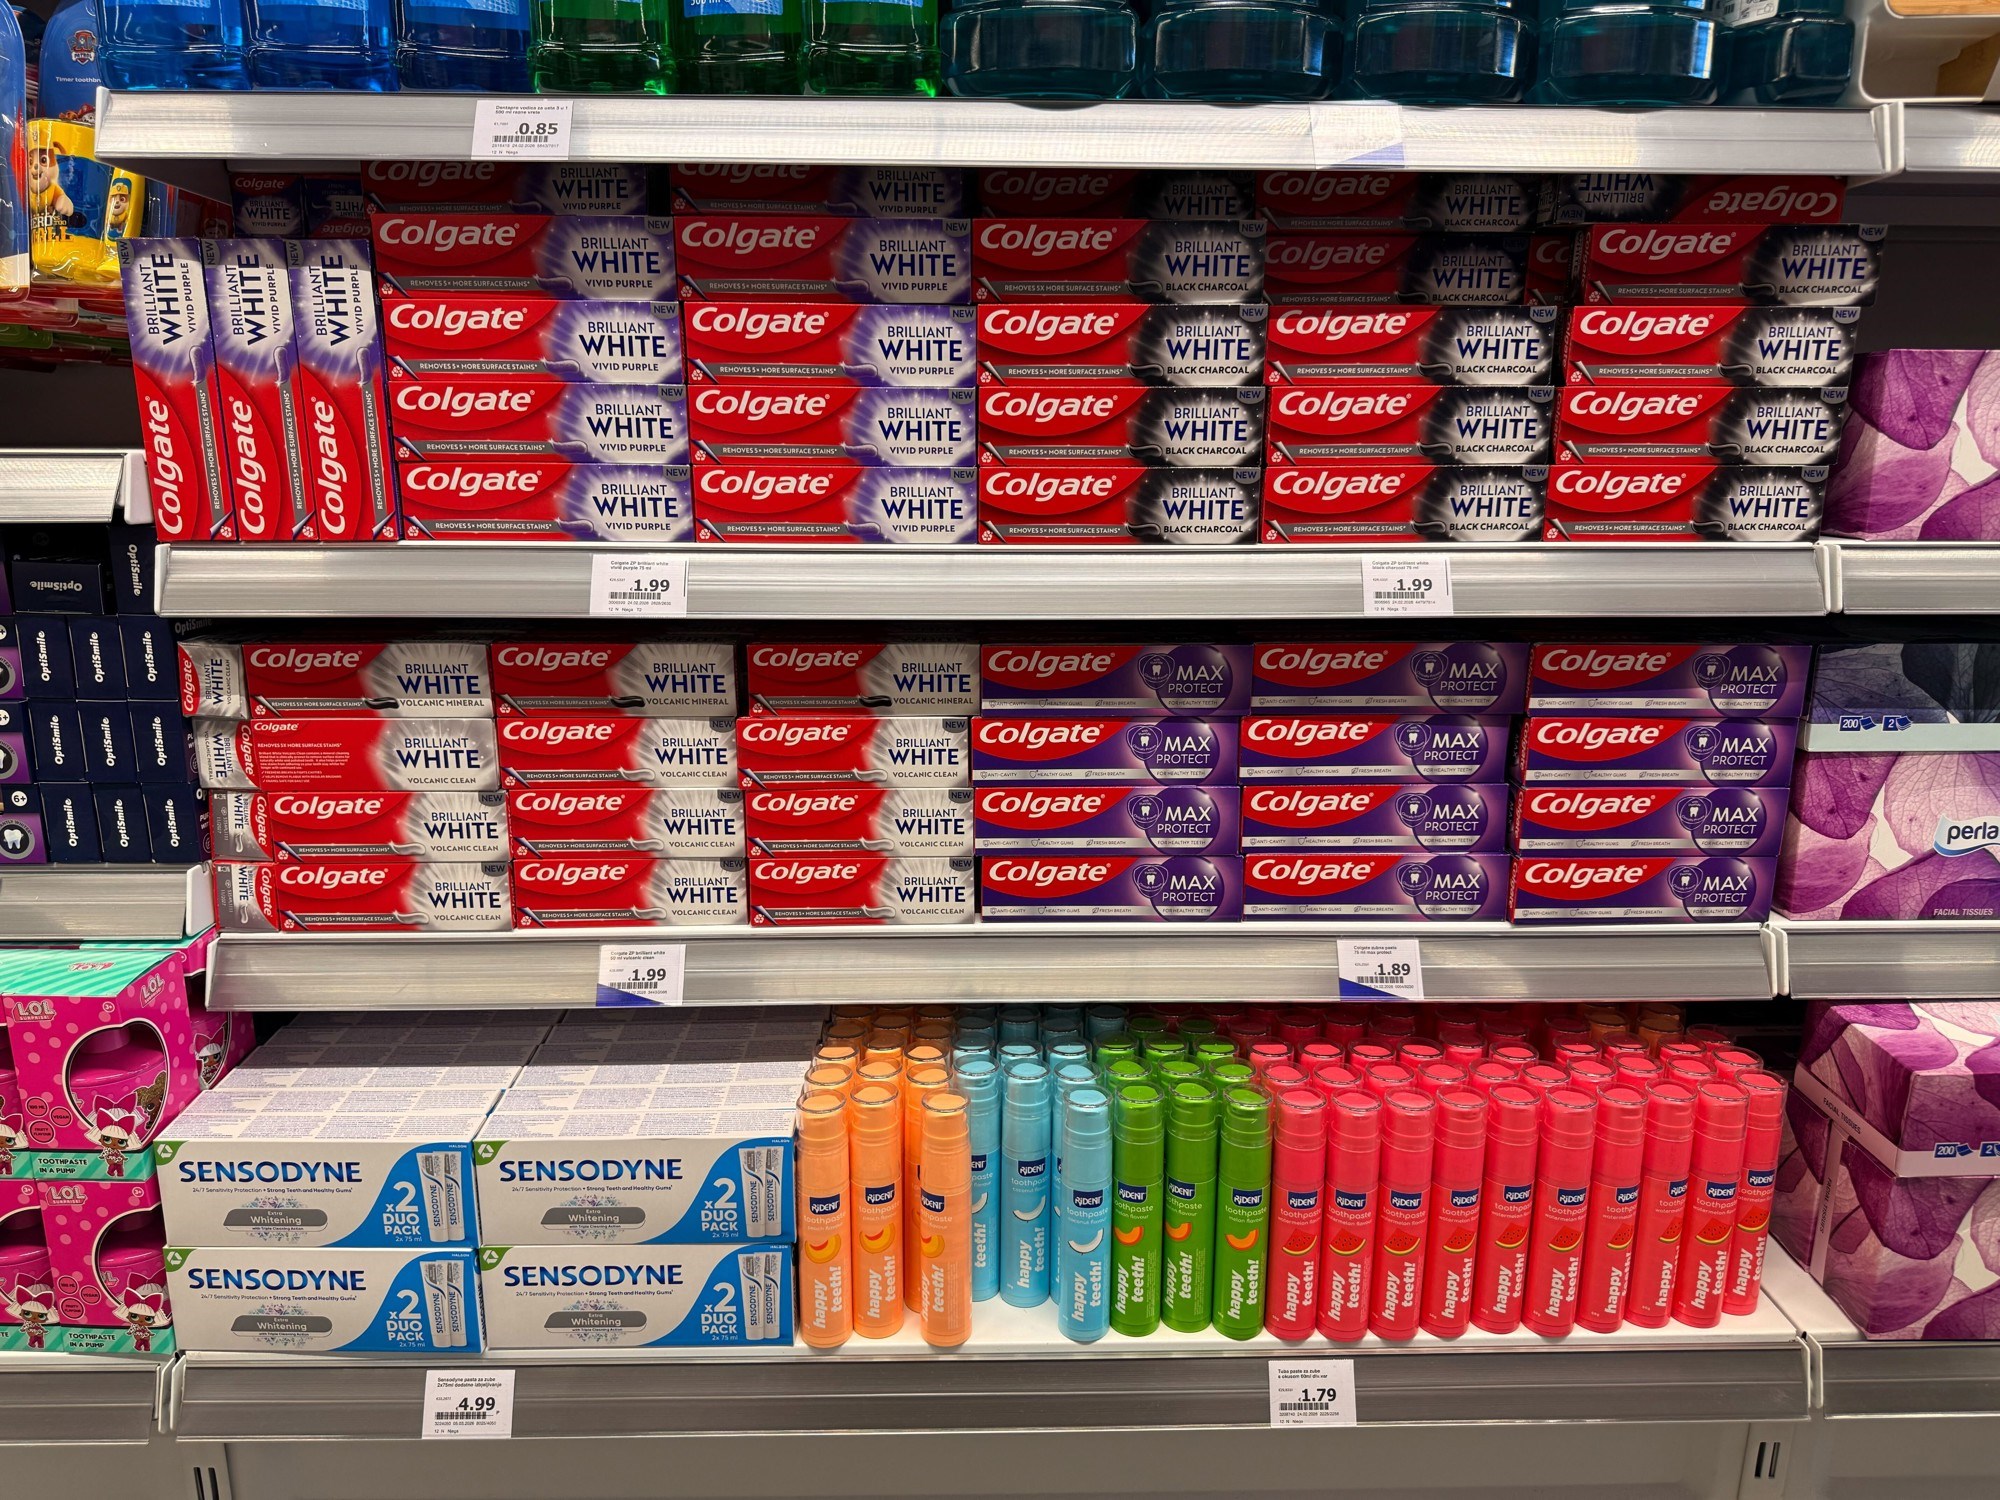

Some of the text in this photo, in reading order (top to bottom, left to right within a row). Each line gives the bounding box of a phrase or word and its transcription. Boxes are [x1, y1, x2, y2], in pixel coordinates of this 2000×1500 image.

[553, 180, 629, 199] WHITE
[1709, 186, 1838, 217] Colgate
[379, 219, 516, 251] Colgate
[581, 237, 649, 249] BRILLIANT
[681, 222, 816, 254] Colgate
[1599, 229, 1731, 260] Colgate
[572, 250, 661, 273] WHITE
[870, 253, 956, 276] WHITE
[1782, 258, 1868, 279] WHITE
[139, 264, 160, 335] BRILLIANT
[152, 253, 183, 345] WHITE
[180, 262, 197, 333] VIVID PURPLE
[1778, 285, 1863, 293] BLACK CHARCOAL
[390, 304, 524, 335] Colgate
[654, 305, 676, 314] NEW
[1242, 308, 1264, 317] NEW
[588, 322, 655, 333] BRILLIANT
[692, 307, 825, 339] Colgate
[984, 310, 1115, 341] Colgate
[1176, 326, 1242, 337] BRILLIANT
[1276, 310, 1406, 340] Colgate
[1580, 311, 1710, 341] Colgate
[1768, 326, 1835, 338] BRILLIANT
[579, 335, 666, 357] WHITE
[1166, 338, 1250, 360] WHITE
[1758, 339, 1841, 360] WHITE
[592, 363, 658, 371] VIVID PURPLE
[1167, 366, 1249, 374] BLACK CHARCOAL
[397, 386, 532, 417] Colgate
[985, 392, 1114, 422] Colgate
[155, 401, 183, 534] Colgate
[318, 401, 347, 535] Colgate
[407, 467, 539, 496] Colgate
[986, 472, 1113, 501] Colgate
[1273, 471, 1401, 500] Colgate
[593, 496, 679, 517] WHITE
[128, 544, 141, 597] OptiSmile
[29, 580, 83, 592] OptiSmile
[38, 630, 50, 682] OptiSmile
[250, 648, 360, 673] Colgate
[498, 648, 608, 670] Colgate
[989, 651, 1111, 677] Colgate
[405, 664, 468, 674] BRILLIANT
[183, 659, 194, 712] Colgate
[397, 675, 480, 694] WHITE
[254, 722, 298, 733] Colgate
[503, 722, 612, 744] Colgate
[1842, 719, 1857, 728] 200
[1888, 719, 1894, 728] 2
[979, 722, 1100, 748] Colgate
[1165, 737, 1210, 751] MAX
[1721, 738, 1769, 752] MAX
[1156, 754, 1210, 764] PROTECT
[1712, 756, 1767, 765] PROTECT
[274, 796, 381, 820] Colgate
[67, 798, 78, 847] OptiSmile
[1947, 822, 1999, 844] perla
[280, 866, 385, 888] Colgate
[755, 862, 858, 884] Colgate
[1252, 859, 1371, 885] Colgate
[1434, 874, 1480, 889] MAX
[428, 892, 501, 908] WHITE
[896, 887, 965, 902] WHITE
[1425, 891, 1479, 900] PROTECT
[1823, 1098, 1861, 1135] FACIAL TISSUES
[1937, 1146, 1954, 1155] 200
[39, 1158, 87, 1166] TOOTHPASTE
[179, 1161, 362, 1183] SENSODYNE
[500, 1159, 683, 1182] SENSODYNE
[250, 1215, 301, 1225] Whitening
[383, 1214, 420, 1225] DUO
[384, 1225, 420, 1235] PACK
[188, 1268, 366, 1291] SENSODYNE
[504, 1265, 683, 1287] SENSODYNE
[1090, 1261, 1102, 1307] teeth!
[1246, 1260, 1259, 1306] teeth!
[1712, 1251, 1727, 1295] teeth!
[829, 1266, 842, 1313] teeth!
[1347, 1263, 1361, 1308] teeth!
[1546, 1268, 1565, 1317] happy
[1691, 1261, 1712, 1309] happy
[813, 1280, 828, 1328] happy
[1071, 1272, 1087, 1322] happy
[701, 1314, 736, 1324] DUO
